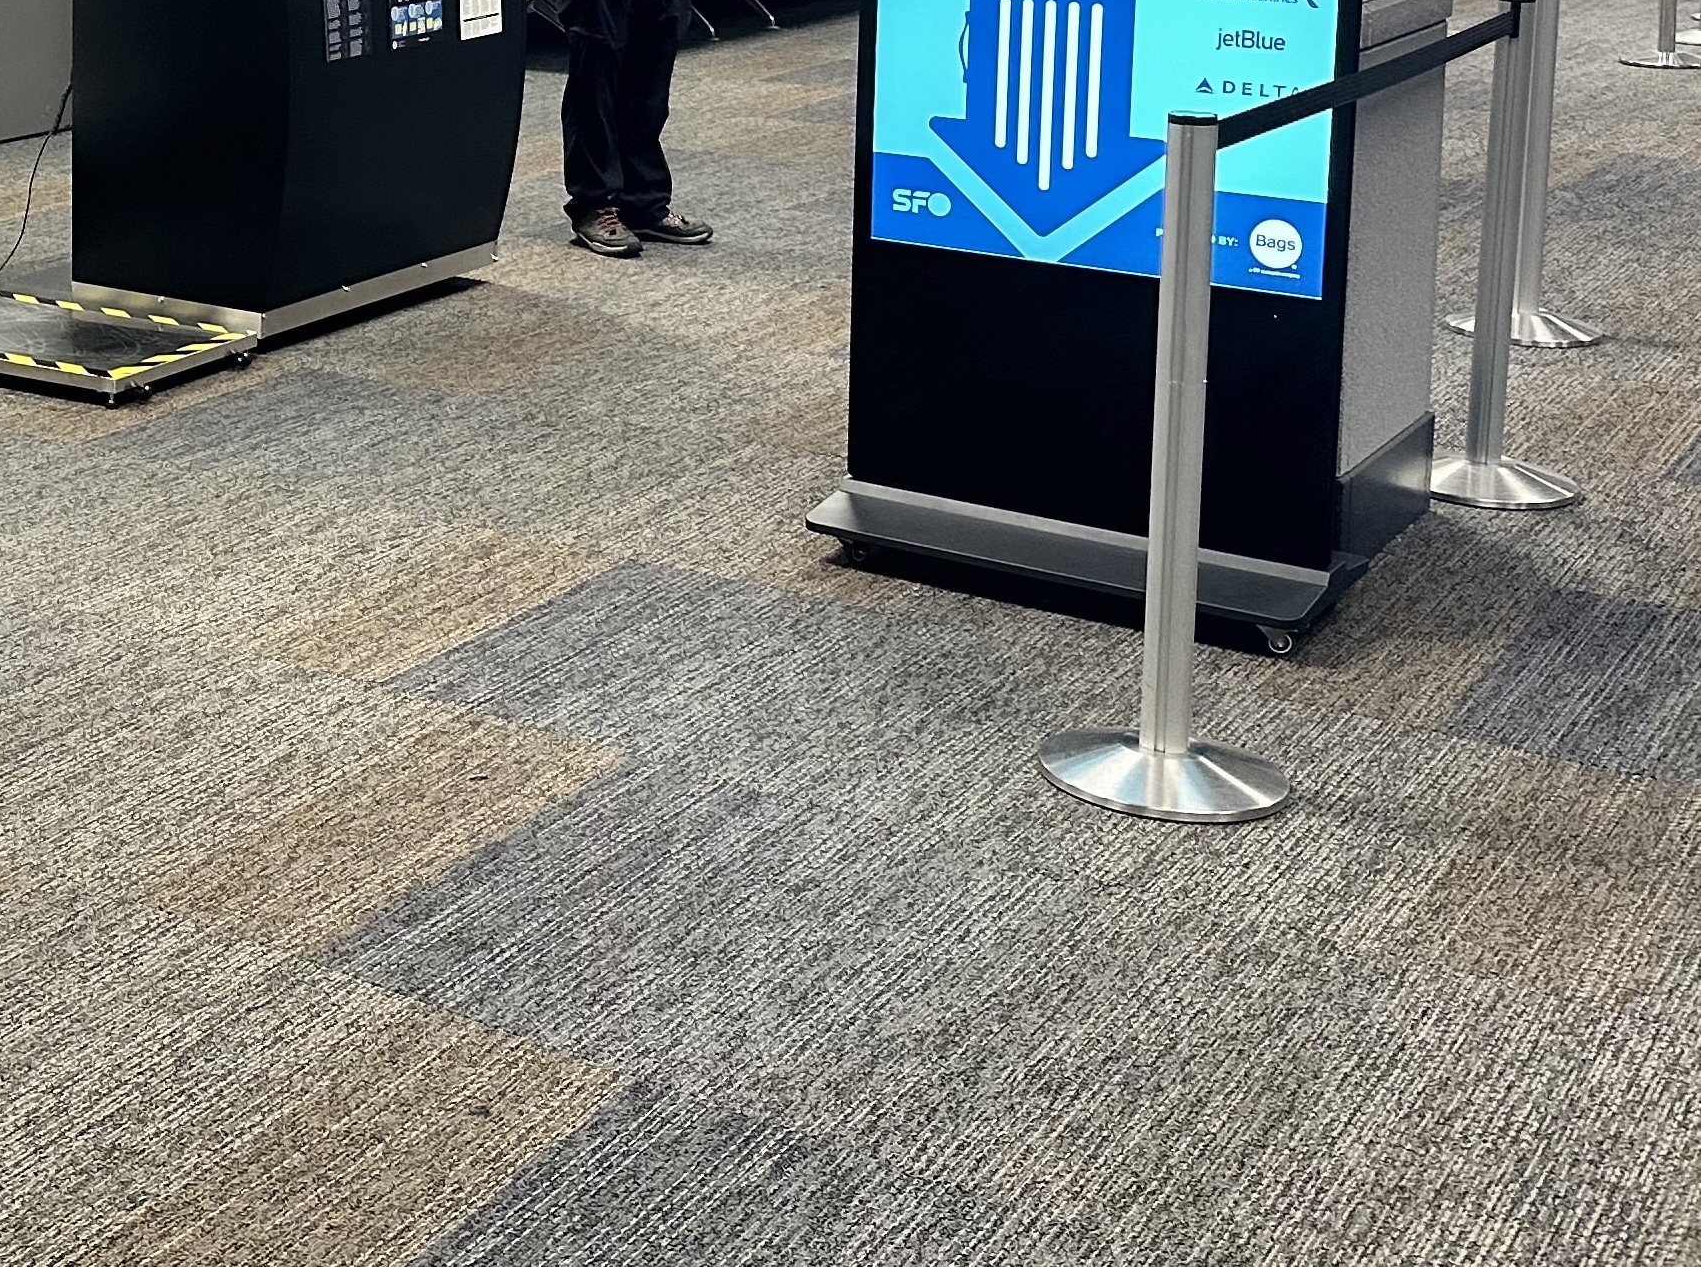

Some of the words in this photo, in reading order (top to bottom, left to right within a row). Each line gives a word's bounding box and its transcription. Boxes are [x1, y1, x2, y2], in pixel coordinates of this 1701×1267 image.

[1215, 27, 1286, 51] jetBlue
[892, 188, 952, 217] SFO
[1255, 234, 1296, 252] Bags
